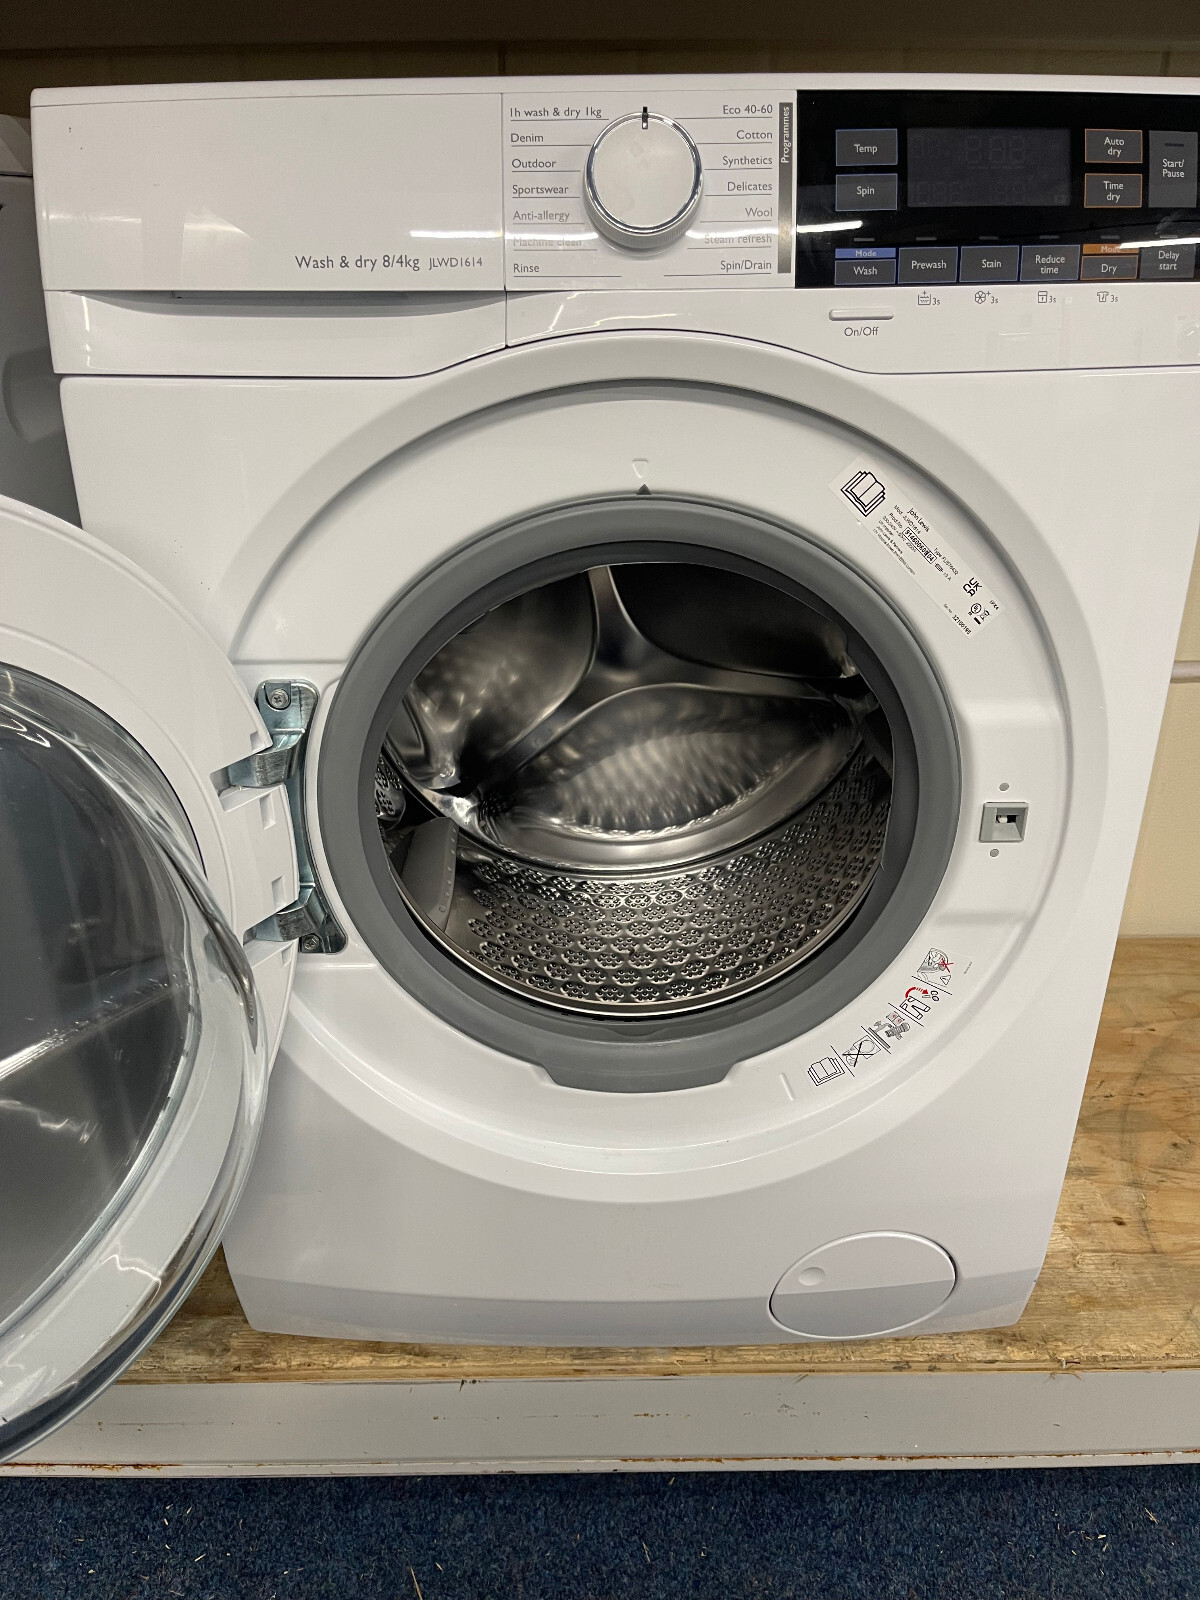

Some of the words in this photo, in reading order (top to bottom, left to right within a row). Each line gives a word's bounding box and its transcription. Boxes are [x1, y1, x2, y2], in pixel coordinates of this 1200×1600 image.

[524, 108, 548, 116] wash
[553, 108, 560, 116] &
[564, 107, 580, 118] dry
[722, 104, 742, 115] Eco
[744, 104, 772, 113] 40-60
[511, 133, 543, 142] Denim
[737, 130, 772, 139] Cotton
[781, 107, 791, 163] Programmes
[1104, 137, 1124, 145] Auto
[854, 144, 877, 155] Temp
[1108, 147, 1121, 157] dry
[512, 159, 556, 168] Outdoor
[723, 156, 772, 167] Synthetics
[1163, 159, 1184, 170] Start/
[1163, 169, 1184, 177] Pause
[728, 182, 772, 191] Delicates
[1104, 181, 1123, 189] Time
[513, 185, 569, 196] Sportswear
[857, 186, 874, 197] Spin
[1107, 192, 1120, 203] dry
[513, 210, 569, 222] Anti-allergy
[745, 207, 772, 217] Wool
[704, 233, 736, 245] Steam
[738, 233, 772, 244] refresh
[1036, 255, 1065, 263] Reduce
[1159, 251, 1179, 261] Delay
[295, 256, 333, 268] Wash
[340, 256, 349, 268] &
[355, 255, 377, 272] dry
[383, 255, 420, 271] 8/4kg
[429, 257, 482, 270] JLWD1614
[514, 264, 539, 273] Rinse
[721, 260, 771, 273] Spin/Drain
[912, 260, 946, 269] Prewash
[982, 259, 1001, 268] Stain
[854, 266, 877, 275] Wash
[1041, 266, 1058, 274] time
[1101, 264, 1117, 274] Dry
[991, 296, 998, 304] 3s
[844, 327, 879, 336] On/Off
[906, 507, 920, 520] John
[916, 517, 931, 532] Lewis
[962, 582, 976, 596] CA
[968, 577, 982, 591] UK
